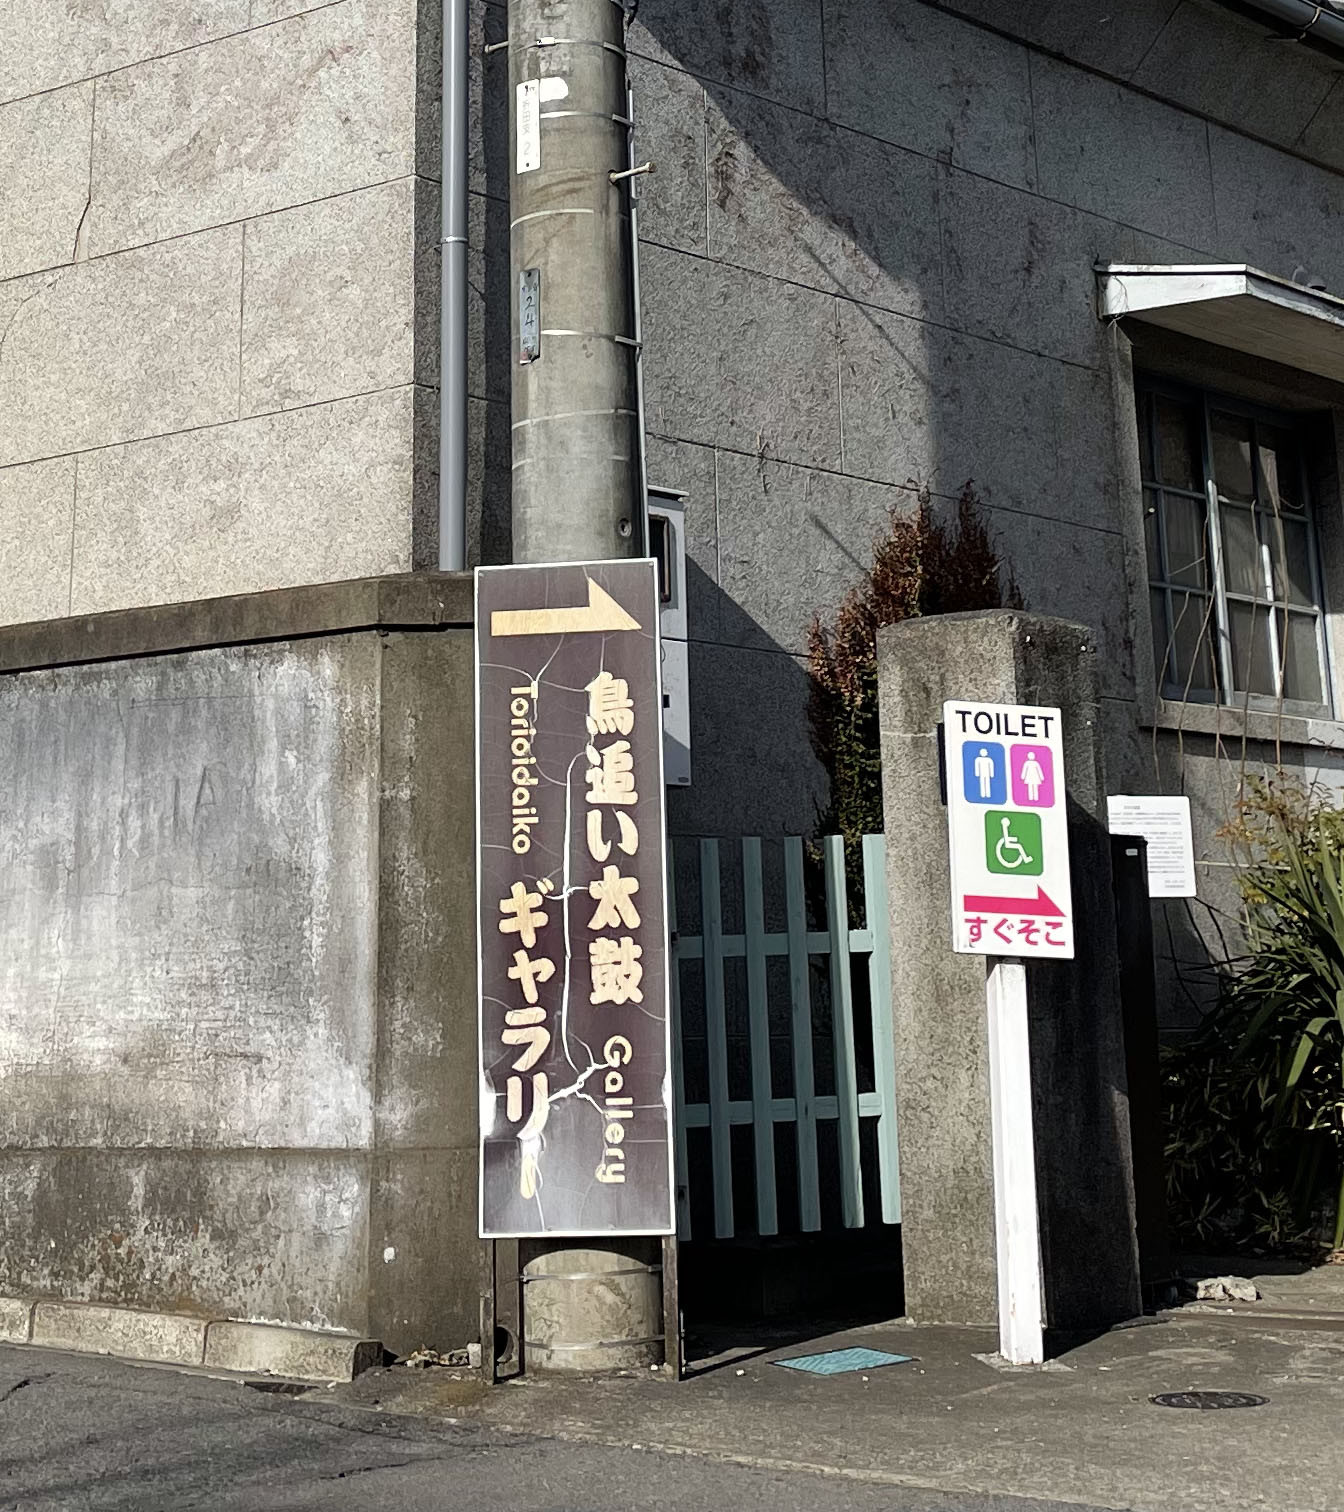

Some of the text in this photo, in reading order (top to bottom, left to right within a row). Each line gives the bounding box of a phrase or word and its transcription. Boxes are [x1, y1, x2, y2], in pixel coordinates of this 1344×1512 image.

[508, 683, 538, 855] Torioidaiko
[955, 709, 1054, 739] TOILET
[584, 671, 643, 1007] 鳥追い太鼓
[964, 915, 1066, 946] すぐそこ
[498, 876, 556, 1200] ギャラリー
[595, 1034, 632, 1185] Gallery
